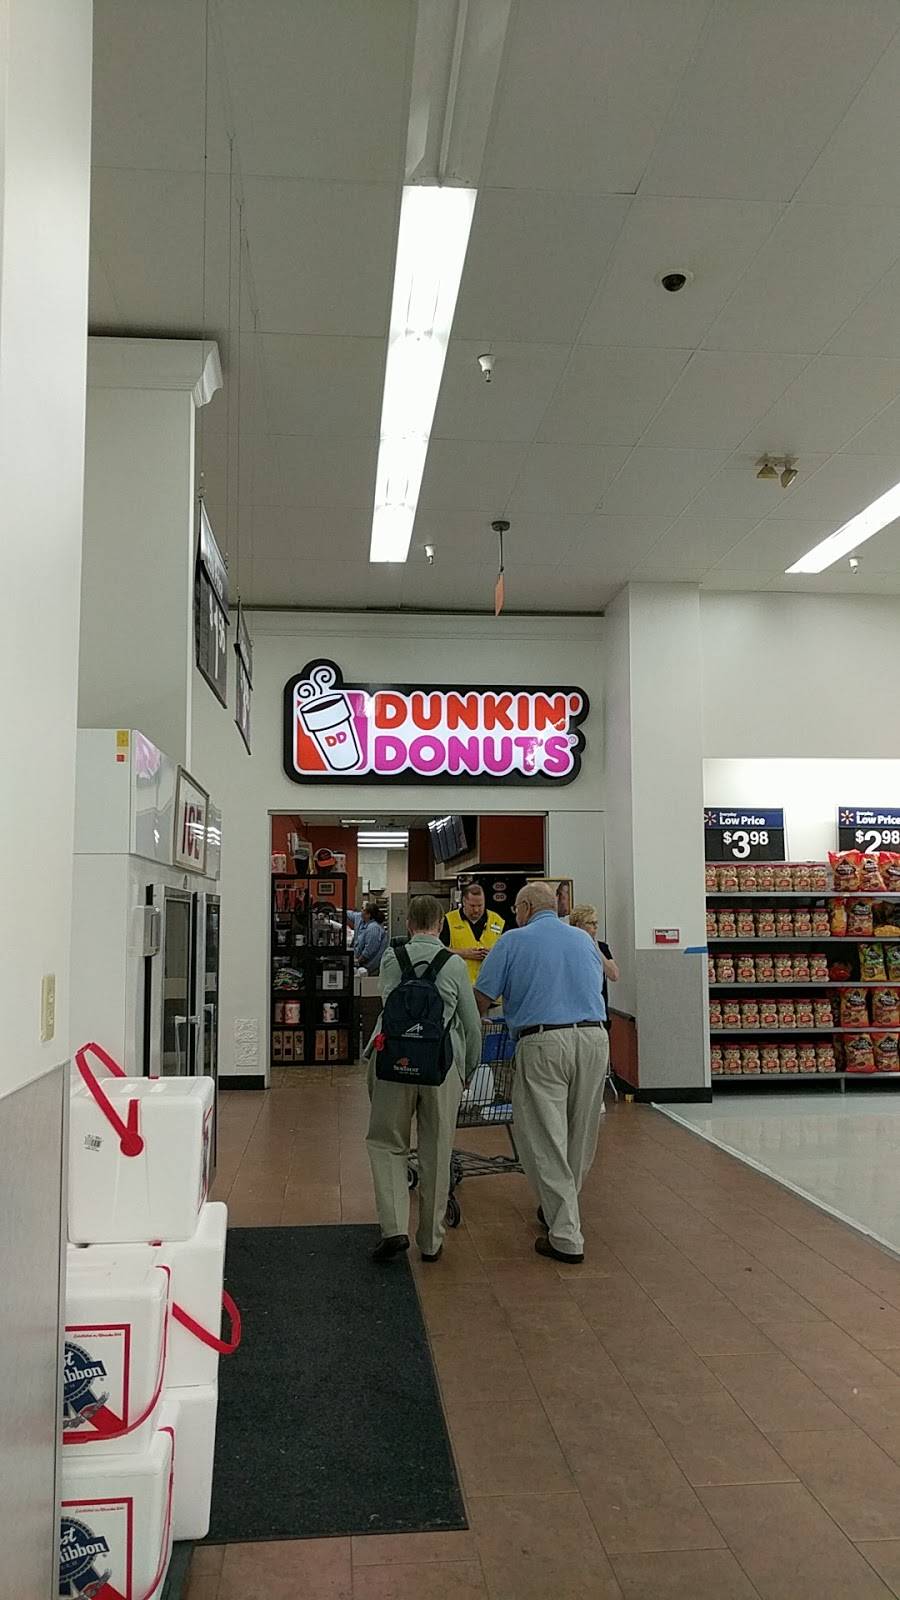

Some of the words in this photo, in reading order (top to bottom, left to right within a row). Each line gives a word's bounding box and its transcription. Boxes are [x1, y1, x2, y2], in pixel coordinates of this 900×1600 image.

[374, 693, 580, 731] DUNKIN'
[324, 731, 347, 747] DD
[719, 816, 740, 825] Low
[741, 816, 766, 825] Price
[856, 815, 876, 825] Low
